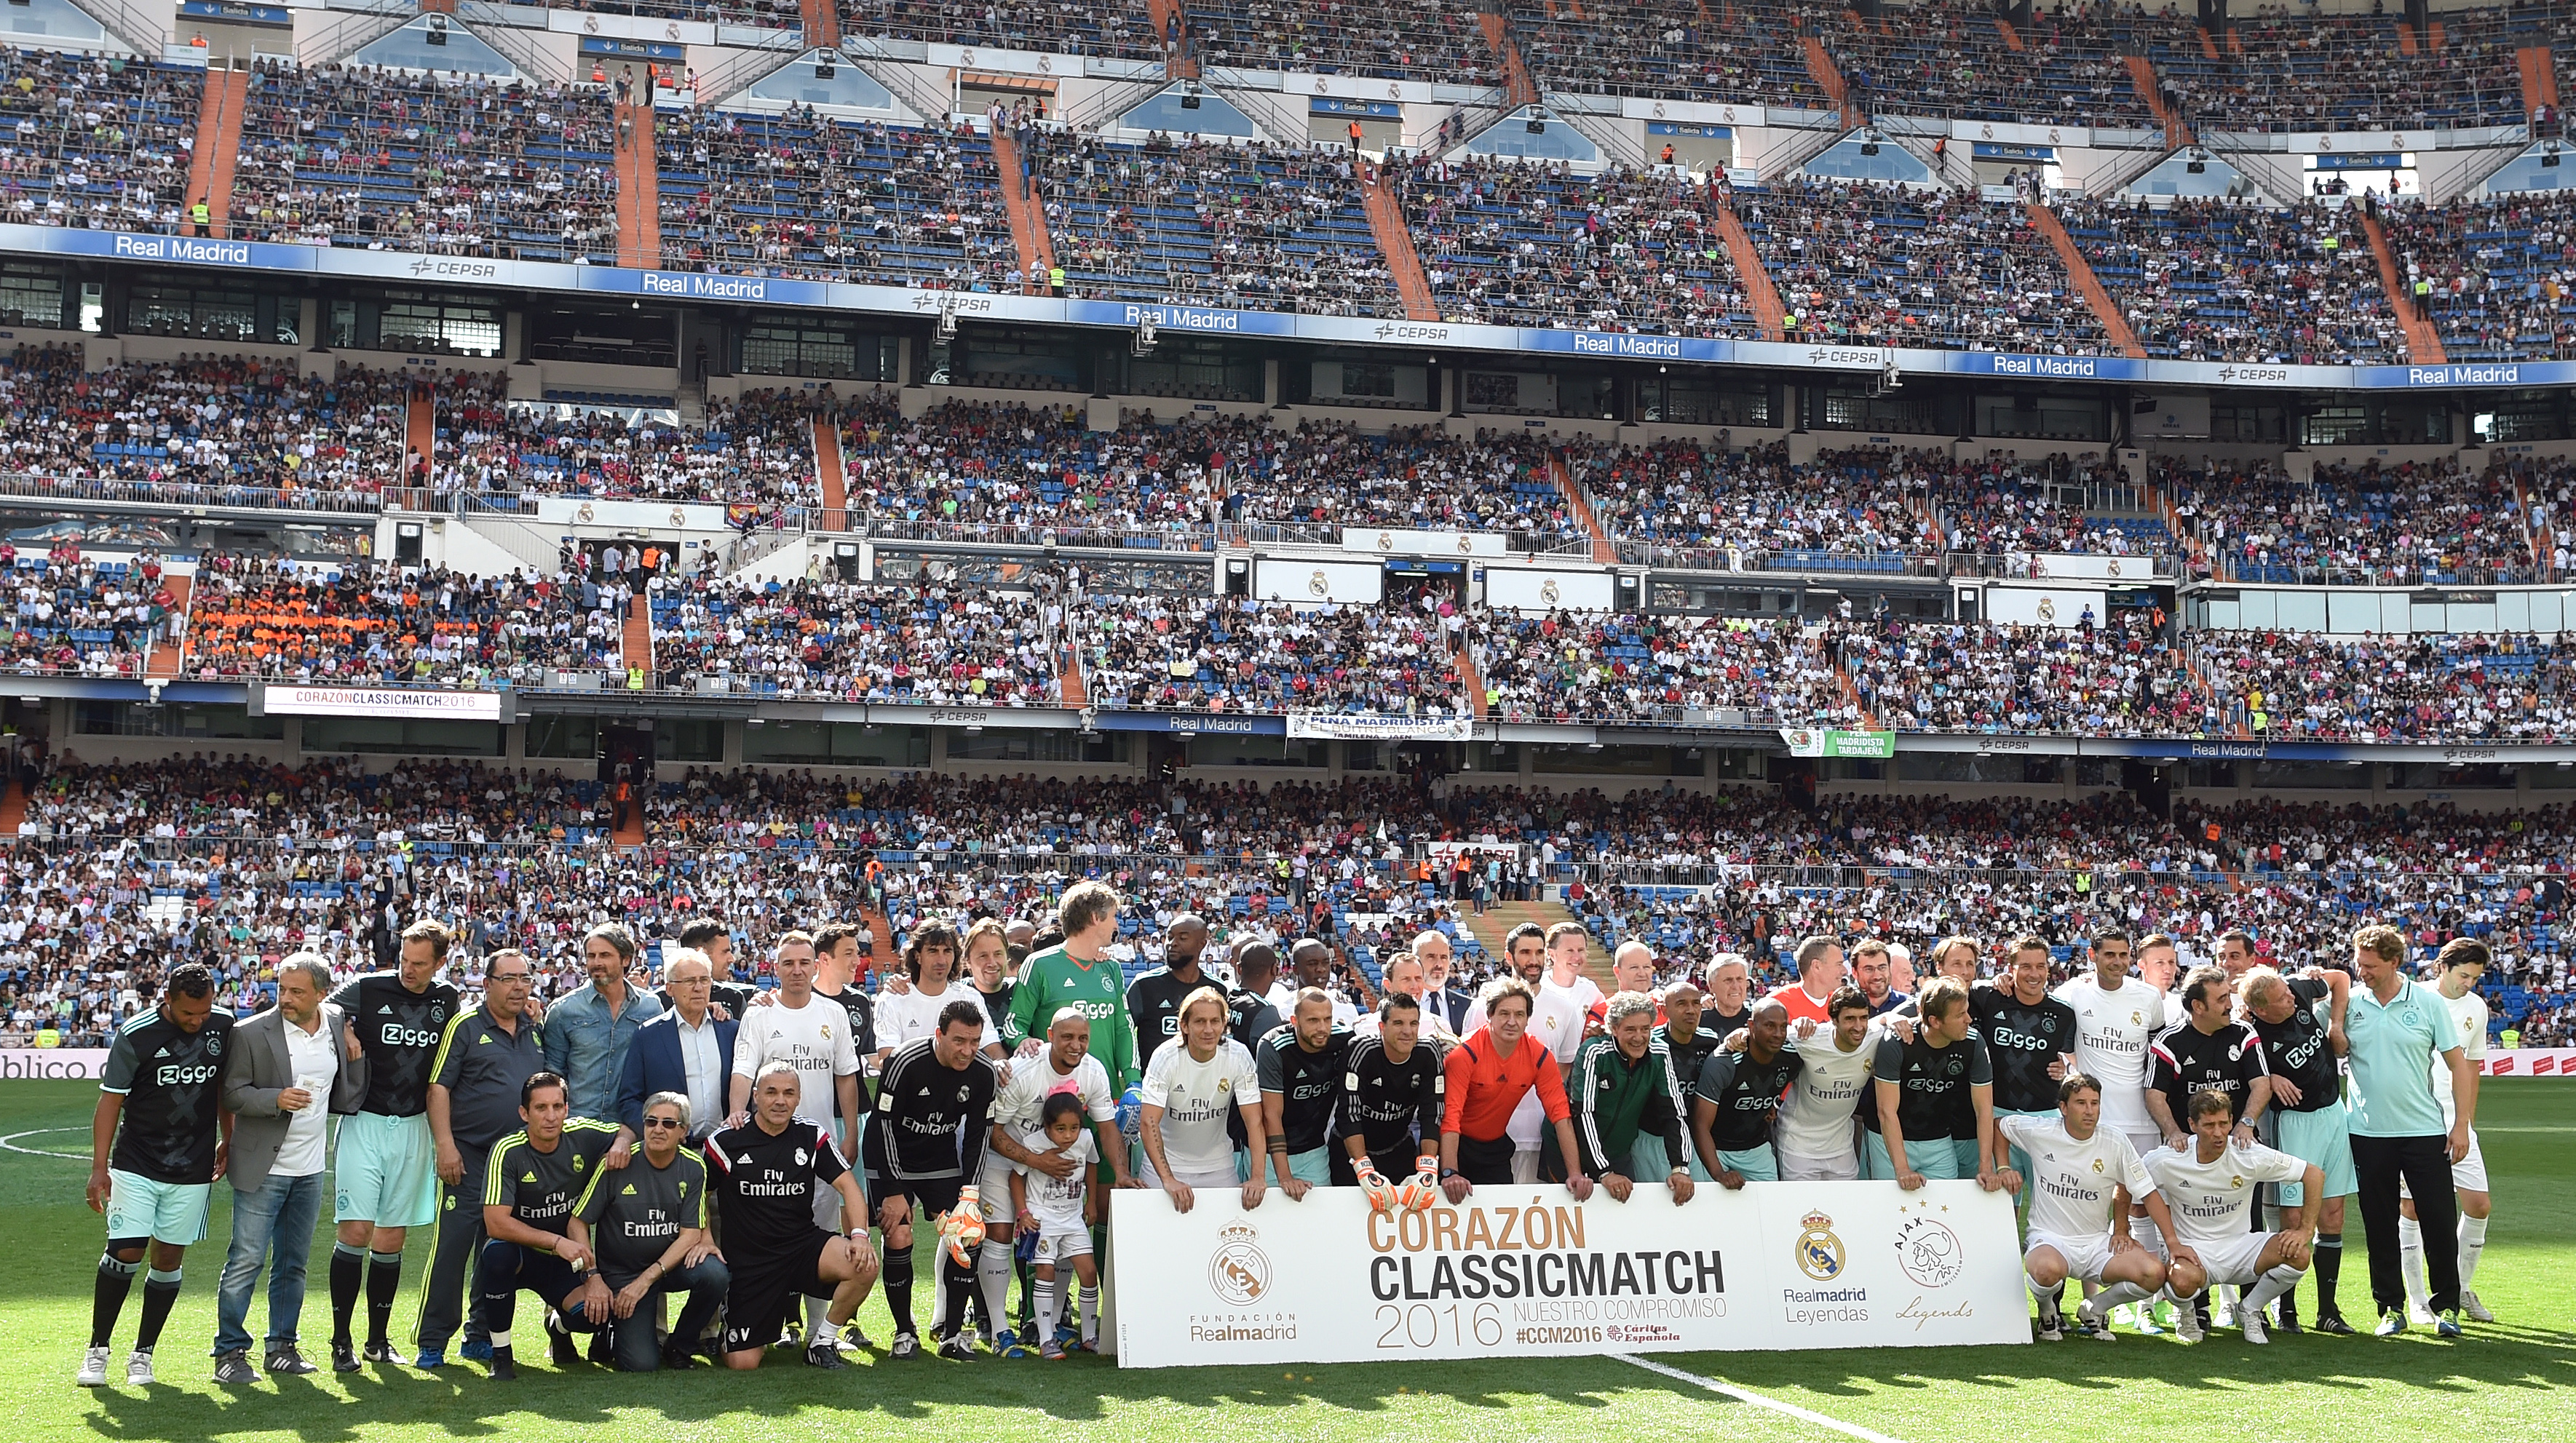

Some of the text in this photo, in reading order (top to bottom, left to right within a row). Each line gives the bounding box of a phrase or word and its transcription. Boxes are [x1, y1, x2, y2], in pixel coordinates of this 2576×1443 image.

[223, 6, 249, 15] Salida
[620, 44, 645, 52] Salida
[1344, 103, 1366, 111] Salida
[1679, 127, 1700, 135] Salida
[2348, 156, 2370, 164] Salida
[116, 236, 247, 263] Real Madrid
[436, 262, 495, 277] CEPSA
[644, 274, 764, 298] Real Madrid
[936, 298, 991, 311] CEPSA
[1126, 306, 1237, 329] Real Madrid
[1397, 327, 1448, 340] CEPSA
[1575, 334, 1679, 356] Real Madrid
[1830, 351, 1878, 364] CEPSA
[1994, 356, 2094, 376] Real Madrid
[2239, 369, 2287, 381] CEPSA
[2409, 366, 2517, 384] Real Madrid
[947, 712, 987, 721] CEPSA
[1170, 717, 1251, 731] Real Madrid
[1311, 723, 1328, 732] EL
[1387, 726, 1447, 734] BLANCO
[1836, 737, 1885, 746] MADRIDISTA
[1994, 741, 2029, 750] CEPSA
[1837, 745, 1883, 755] TARDAJEÑA
[2192, 744, 2263, 756] Real Madrid
[2460, 750, 2496, 758] CEPSA
[381, 1023, 438, 1047] Ziggo
[1994, 1027, 2048, 1050] Ziggo
[2103, 1026, 2123, 1039] Fly
[2082, 1033, 2141, 1052] Emirates
[2285, 1027, 2324, 1069] Ziggo
[793, 1044, 810, 1056] Fly
[157, 1065, 217, 1085] Ziggo
[2206, 1070, 2220, 1080] Fly
[1810, 1084, 1863, 1099] Emirat
[1833, 1080, 1851, 1089] Fly
[1907, 1078, 1954, 1093] Ziggo
[2187, 1078, 2240, 1094] Emirates
[1192, 1098, 1210, 1110] Fly
[1384, 1100, 1403, 1110] Fly
[1362, 1103, 1411, 1121] Emirat
[764, 1169, 784, 1182] Fly
[2060, 1173, 2079, 1186] Fly
[740, 1180, 805, 1196] Emirates
[2040, 1175, 2099, 1201] Emirates
[546, 1191, 565, 1204] Fly
[2203, 1196, 2222, 1205] Fly
[649, 1209, 665, 1221] Fly
[624, 1220, 679, 1237] Emirate
[1368, 1196, 1586, 1252] CORAZÓN
[1895, 1217, 1923, 1250] AJAX
[1370, 1250, 1725, 1300] CLASSICMATCH
[1784, 1287, 1866, 1303] Realmadrid
[1514, 1297, 1727, 1322] NUESTRO COMPROMISO
[1786, 1305, 1868, 1326] Leyendas
[1895, 1295, 1973, 1332] Legends
[1190, 1312, 1296, 1323] FUNDACIÓN
[1191, 1324, 1296, 1342] Realmadrid
[1376, 1303, 1502, 1349] 2016
[1624, 1324, 1668, 1334] Cáritas
[1515, 1326, 1602, 1345] #CCM2016
